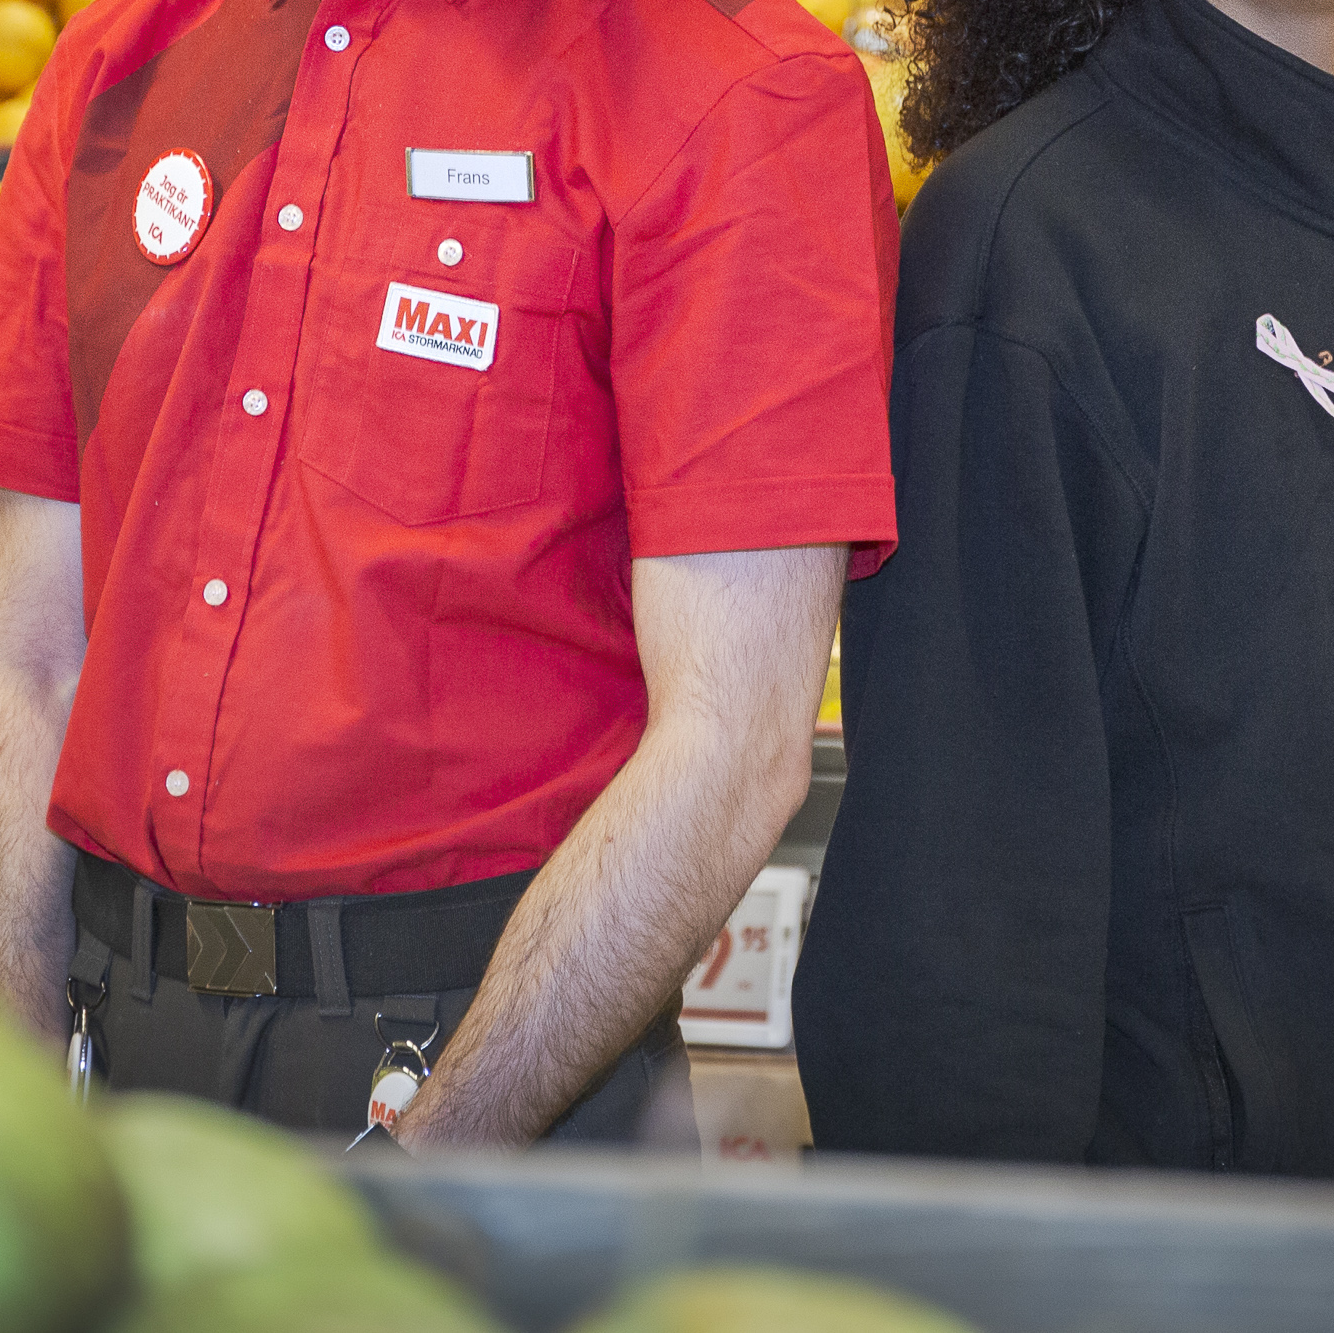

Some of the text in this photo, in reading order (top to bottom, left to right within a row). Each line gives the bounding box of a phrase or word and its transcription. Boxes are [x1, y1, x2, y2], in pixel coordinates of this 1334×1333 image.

[160, 174, 189, 204] Jag är
[447, 168, 490, 185] Frans
[142, 181, 196, 232] PRAKTIKANT
[148, 222, 163, 245] ICA
[394, 296, 489, 349] MAXI
[391, 329, 484, 359] ICA STORMARKNAD
[370, 1100, 405, 1123] MA
